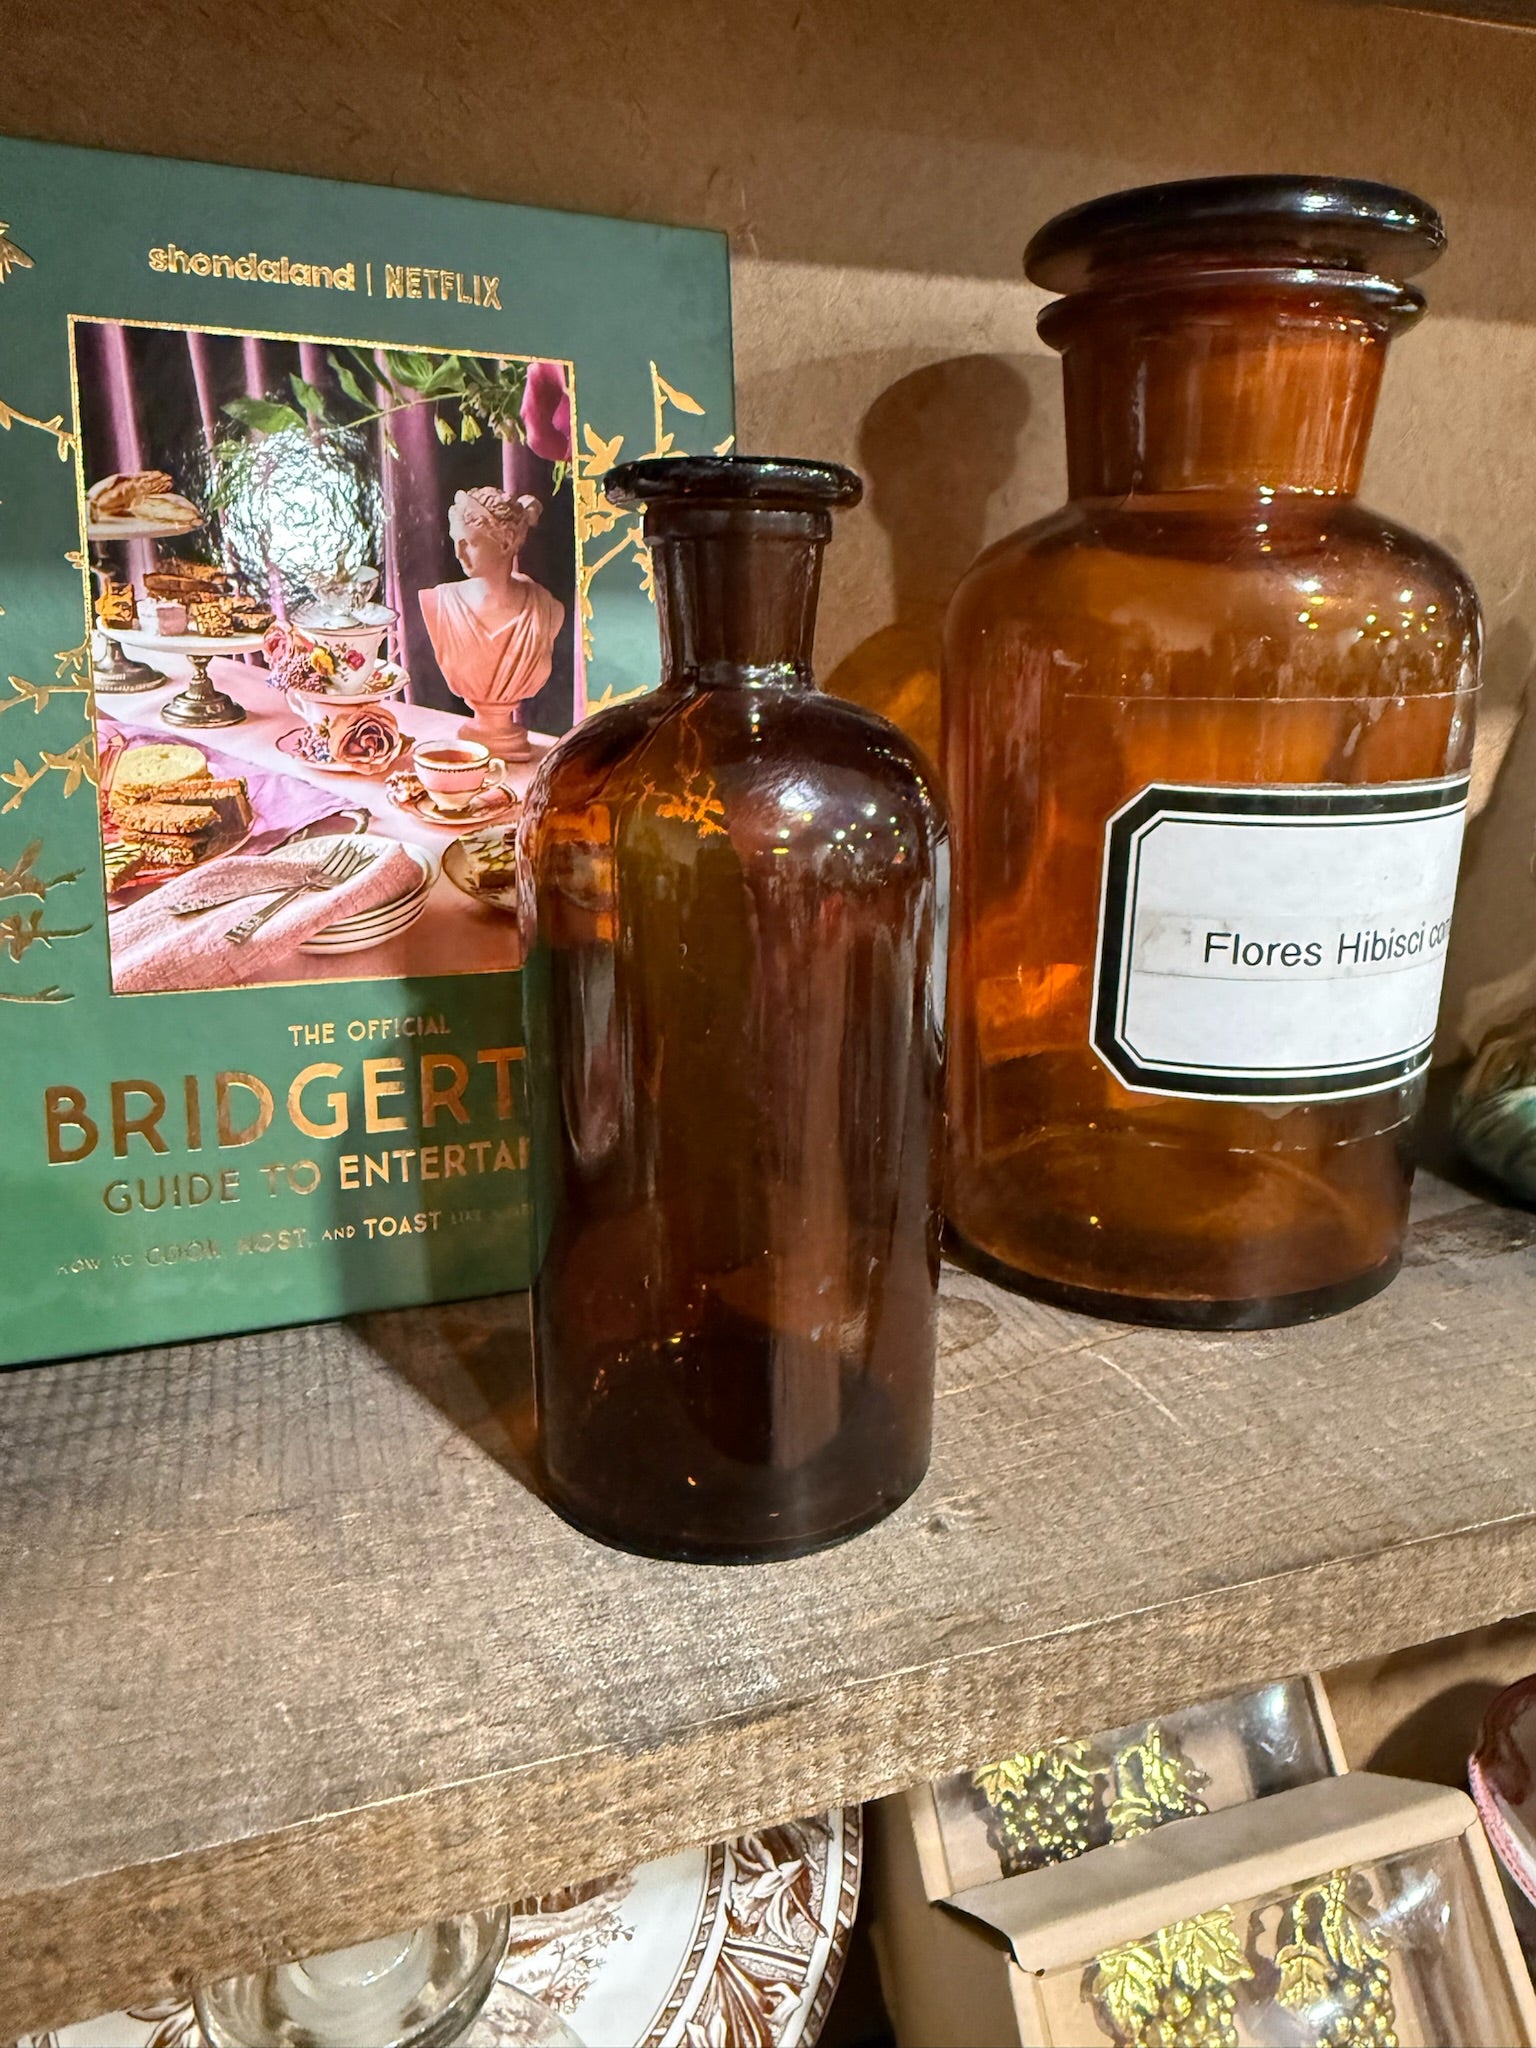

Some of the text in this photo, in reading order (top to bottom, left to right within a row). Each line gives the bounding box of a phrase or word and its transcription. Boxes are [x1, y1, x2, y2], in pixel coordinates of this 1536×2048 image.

[148, 244, 503, 311] shondaland NETFLIX
[1203, 931, 1323, 967] Flores
[1337, 921, 1427, 965] Hibisci
[288, 1014, 452, 1047] THE OFFICIAL
[44, 1046, 527, 1167] BRIDGERT
[103, 1169, 241, 1216] GUIDE
[260, 1160, 322, 1198] TO
[322, 1225, 356, 1241] AND
[363, 1210, 442, 1239] TOAST
